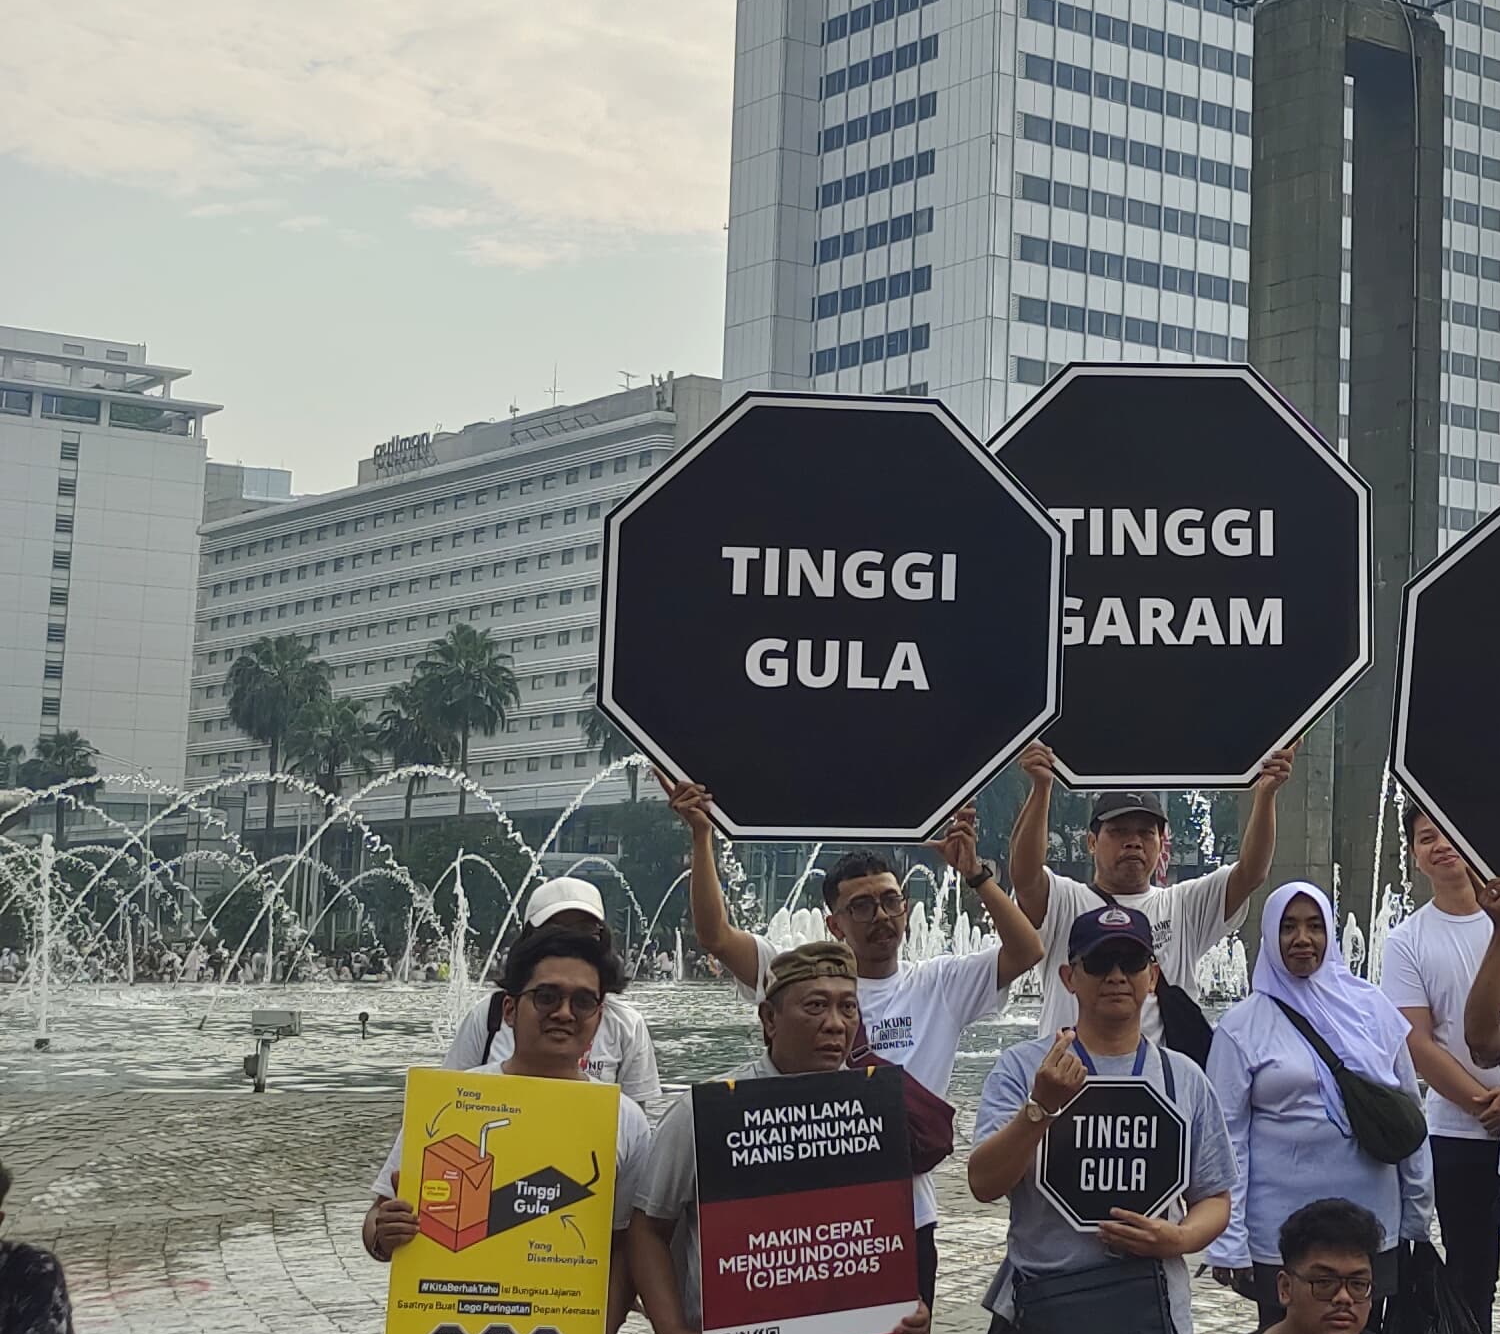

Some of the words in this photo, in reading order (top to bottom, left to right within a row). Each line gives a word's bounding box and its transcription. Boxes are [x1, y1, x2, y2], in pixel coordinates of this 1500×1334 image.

[1047, 508, 1275, 557] TINGGI
[721, 546, 958, 601] TINGGI
[1061, 597, 1284, 646] GARAM
[744, 639, 931, 691] GULA
[743, 1107, 811, 1128] MAKIN
[810, 1100, 865, 1121] LAMA
[726, 1127, 788, 1149] CUKAI
[791, 1117, 883, 1141] MINUMAN
[1073, 1115, 1158, 1149] TINGGI
[731, 1145, 795, 1167] MANIS
[798, 1135, 881, 1160] DITUNDA
[515, 1180, 562, 1201] Tinggi
[1080, 1157, 1146, 1192] GULA
[514, 1198, 550, 1214] Gula
[749, 1228, 812, 1251] MAKIN
[815, 1218, 875, 1242] CEPAT
[718, 1249, 798, 1275] MENUJU
[800, 1235, 904, 1264] INDONESIA
[745, 1264, 830, 1292] (C)EMAS
[833, 1256, 881, 1278] 2045
[459, 1302, 482, 1313] Logo
[483, 1303, 530, 1315] Peringatan
